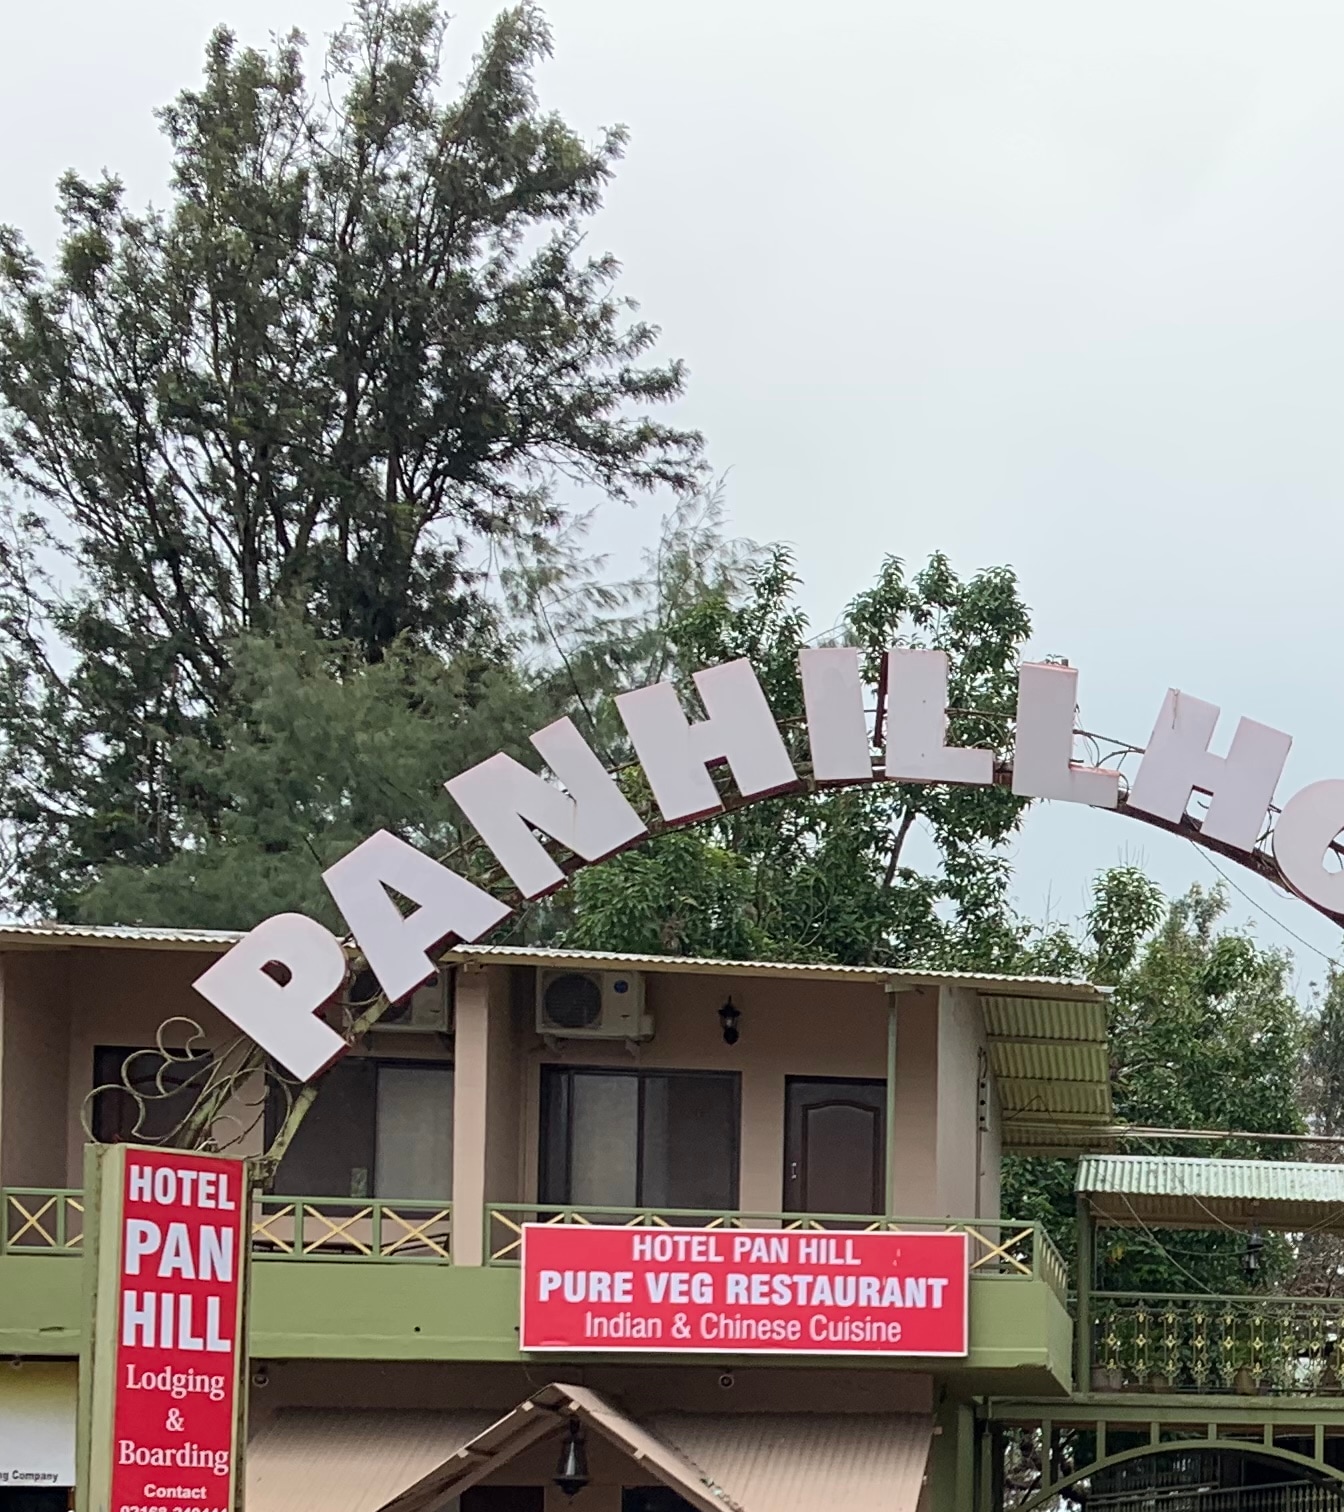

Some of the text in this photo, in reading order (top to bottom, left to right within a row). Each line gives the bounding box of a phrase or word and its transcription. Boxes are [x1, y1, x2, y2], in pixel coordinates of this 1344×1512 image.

[129, 1164, 235, 1210] HOTEL
[125, 1221, 233, 1282] PAN
[632, 1234, 861, 1266] HOTEL PAN HILL
[539, 1270, 948, 1309] PURE VEG RESTAURANT
[122, 1290, 231, 1352] HILL
[584, 1311, 902, 1343] Indian & Chinese Cuisine
[126, 1364, 225, 1401] Lodging
[165, 1407, 185, 1432] &
[118, 1439, 229, 1476] Boarding
[12, 1470, 58, 1483] Company
[143, 1483, 207, 1500] Contact
